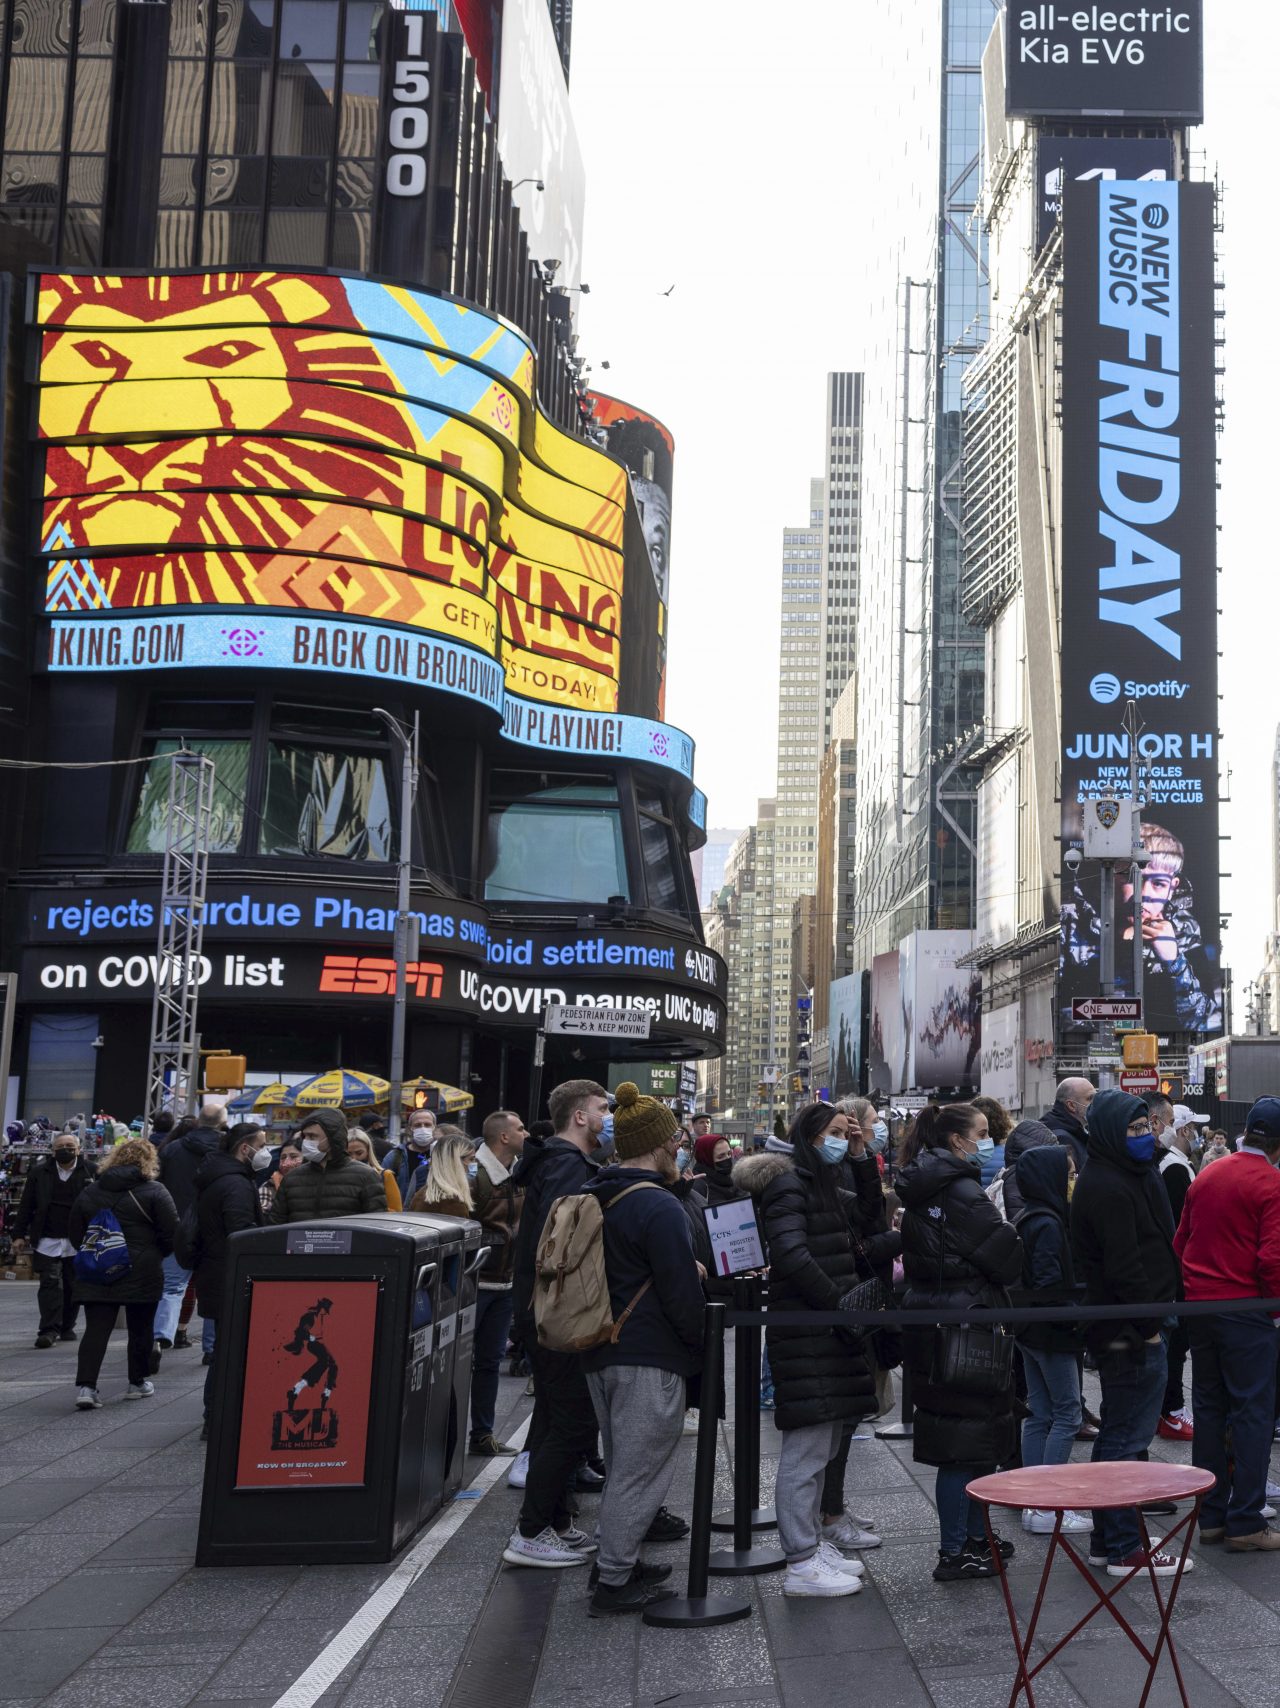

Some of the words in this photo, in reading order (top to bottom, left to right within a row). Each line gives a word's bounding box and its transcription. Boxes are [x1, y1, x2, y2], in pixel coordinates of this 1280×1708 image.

[1019, 5, 1190, 33] all-electric
[1020, 37, 1069, 64] Kia
[1081, 38, 1145, 65] EV6
[386, 15, 430, 196] 1500
[1108, 193, 1138, 306] MUSIC
[1141, 232, 1170, 317] NEW
[1099, 308, 1181, 661] FRIDAY
[401, 450, 490, 588] LIO
[49, 623, 184, 666] KING.COM
[293, 625, 366, 670] BACK
[375, 634, 408, 677] ON
[443, 602, 480, 628] GET
[520, 666, 597, 702] TODAY!
[1124, 680, 1187, 698] Spotify
[527, 708, 624, 752] PLAYING!
[1066, 733, 1182, 759] JUNOR
[1191, 734, 1212, 758] H
[1098, 766, 1128, 777] NEW
[1132, 766, 1182, 777] INGLES
[1114, 779, 1147, 790] PAA
[1150, 779, 1201, 790] AMARTE
[1171, 792, 1204, 803] CLUB
[47, 898, 154, 936] rejects
[542, 938, 675, 971] settlement
[40, 962, 87, 989] on
[98, 955, 212, 988] COVID
[223, 955, 285, 987] list
[318, 955, 444, 999] ESPN
[560, 1009, 604, 1020] PEDESTRIAN
[606, 1011, 626, 1021] FLOW
[628, 1013, 647, 1023] ZONE
[664, 993, 691, 1021] UNC
[692, 1002, 702, 1025] to
[702, 1007, 716, 1034] play
[1083, 1005, 1102, 1013] ONE
[1111, 1005, 1133, 1013] WAY
[598, 1023, 616, 1033] KEEP
[618, 1024, 646, 1035] MOVING
[651, 1069, 676, 1079] UCKS
[651, 1081, 664, 1089] EE
[299, 1097, 339, 1106] SABRETT
[951, 1356, 980, 1367] TOTE
[970, 1348, 992, 1358] THE
